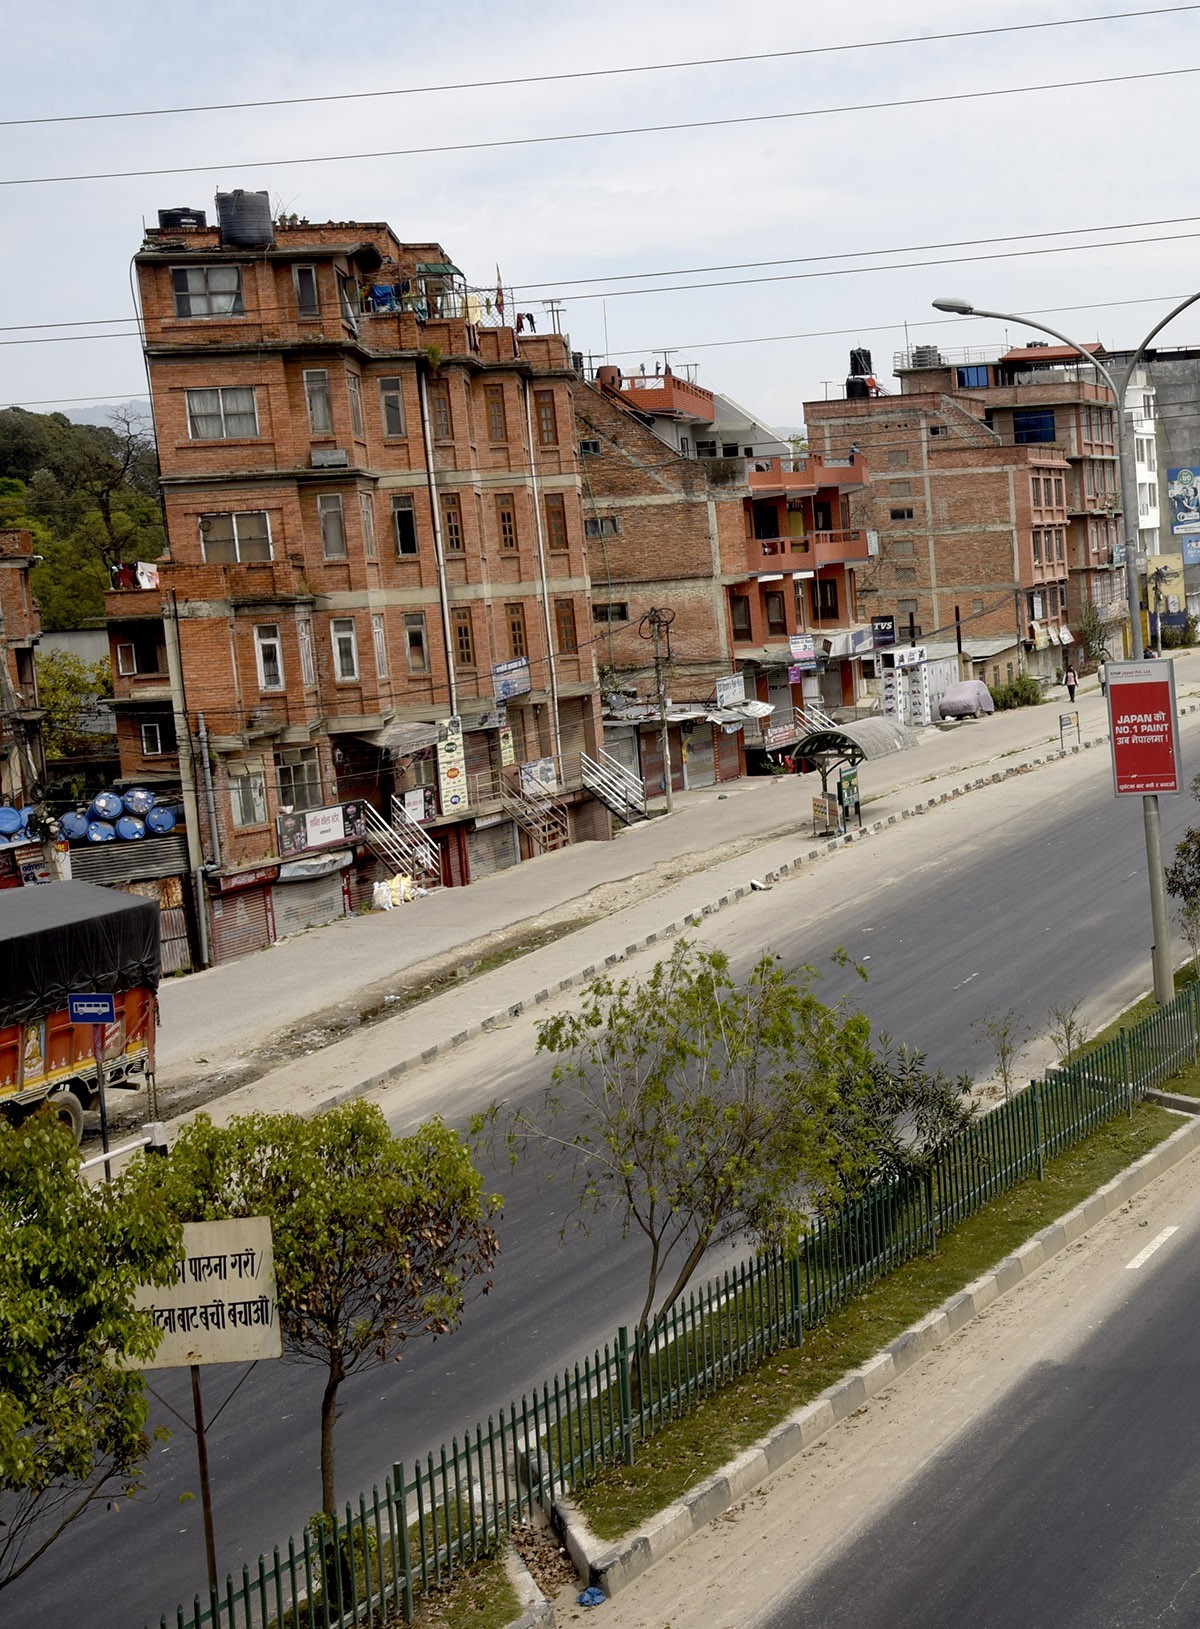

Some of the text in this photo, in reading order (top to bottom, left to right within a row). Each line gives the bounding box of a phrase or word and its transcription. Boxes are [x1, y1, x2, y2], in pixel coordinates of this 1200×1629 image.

[873, 621, 893, 630] TVS
[1117, 711, 1166, 724] JAPAN को
[1140, 723, 1169, 733] PAINT
[188, 1255, 227, 1282] पालना
[177, 1306, 199, 1332] बाट
